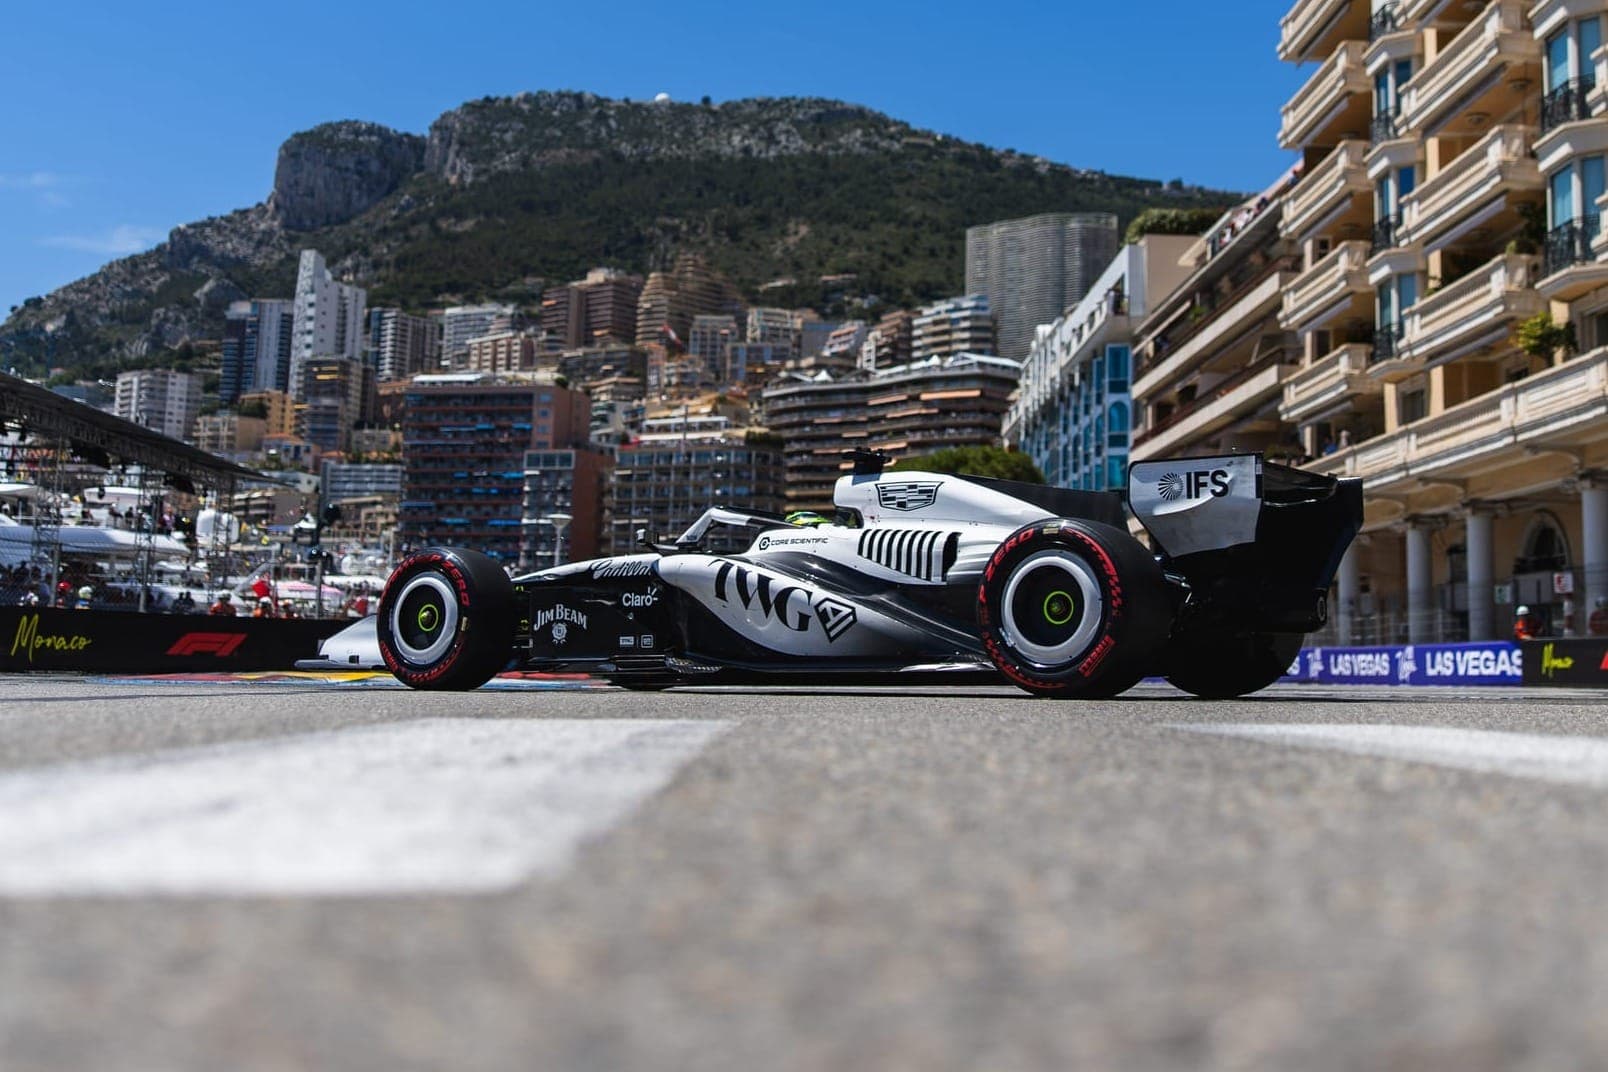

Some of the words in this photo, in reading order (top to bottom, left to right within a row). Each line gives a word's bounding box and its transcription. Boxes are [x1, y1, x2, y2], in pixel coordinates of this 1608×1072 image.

[1186, 469, 1229, 499] IFS
[790, 537, 829, 545] SCIENTIFIC
[985, 527, 1035, 582] ZERO
[441, 560, 471, 607] ZERO
[707, 558, 814, 632] TWG
[622, 592, 653, 607] Claro
[533, 608, 555, 631] JIM
[555, 603, 588, 630] BEAM
[10, 613, 92, 662] Monaco
[1329, 653, 1351, 676] LAS
[1350, 653, 1390, 676] VEGAS
[1425, 650, 1455, 676] LAS
[1455, 649, 1523, 676] VEGAS
